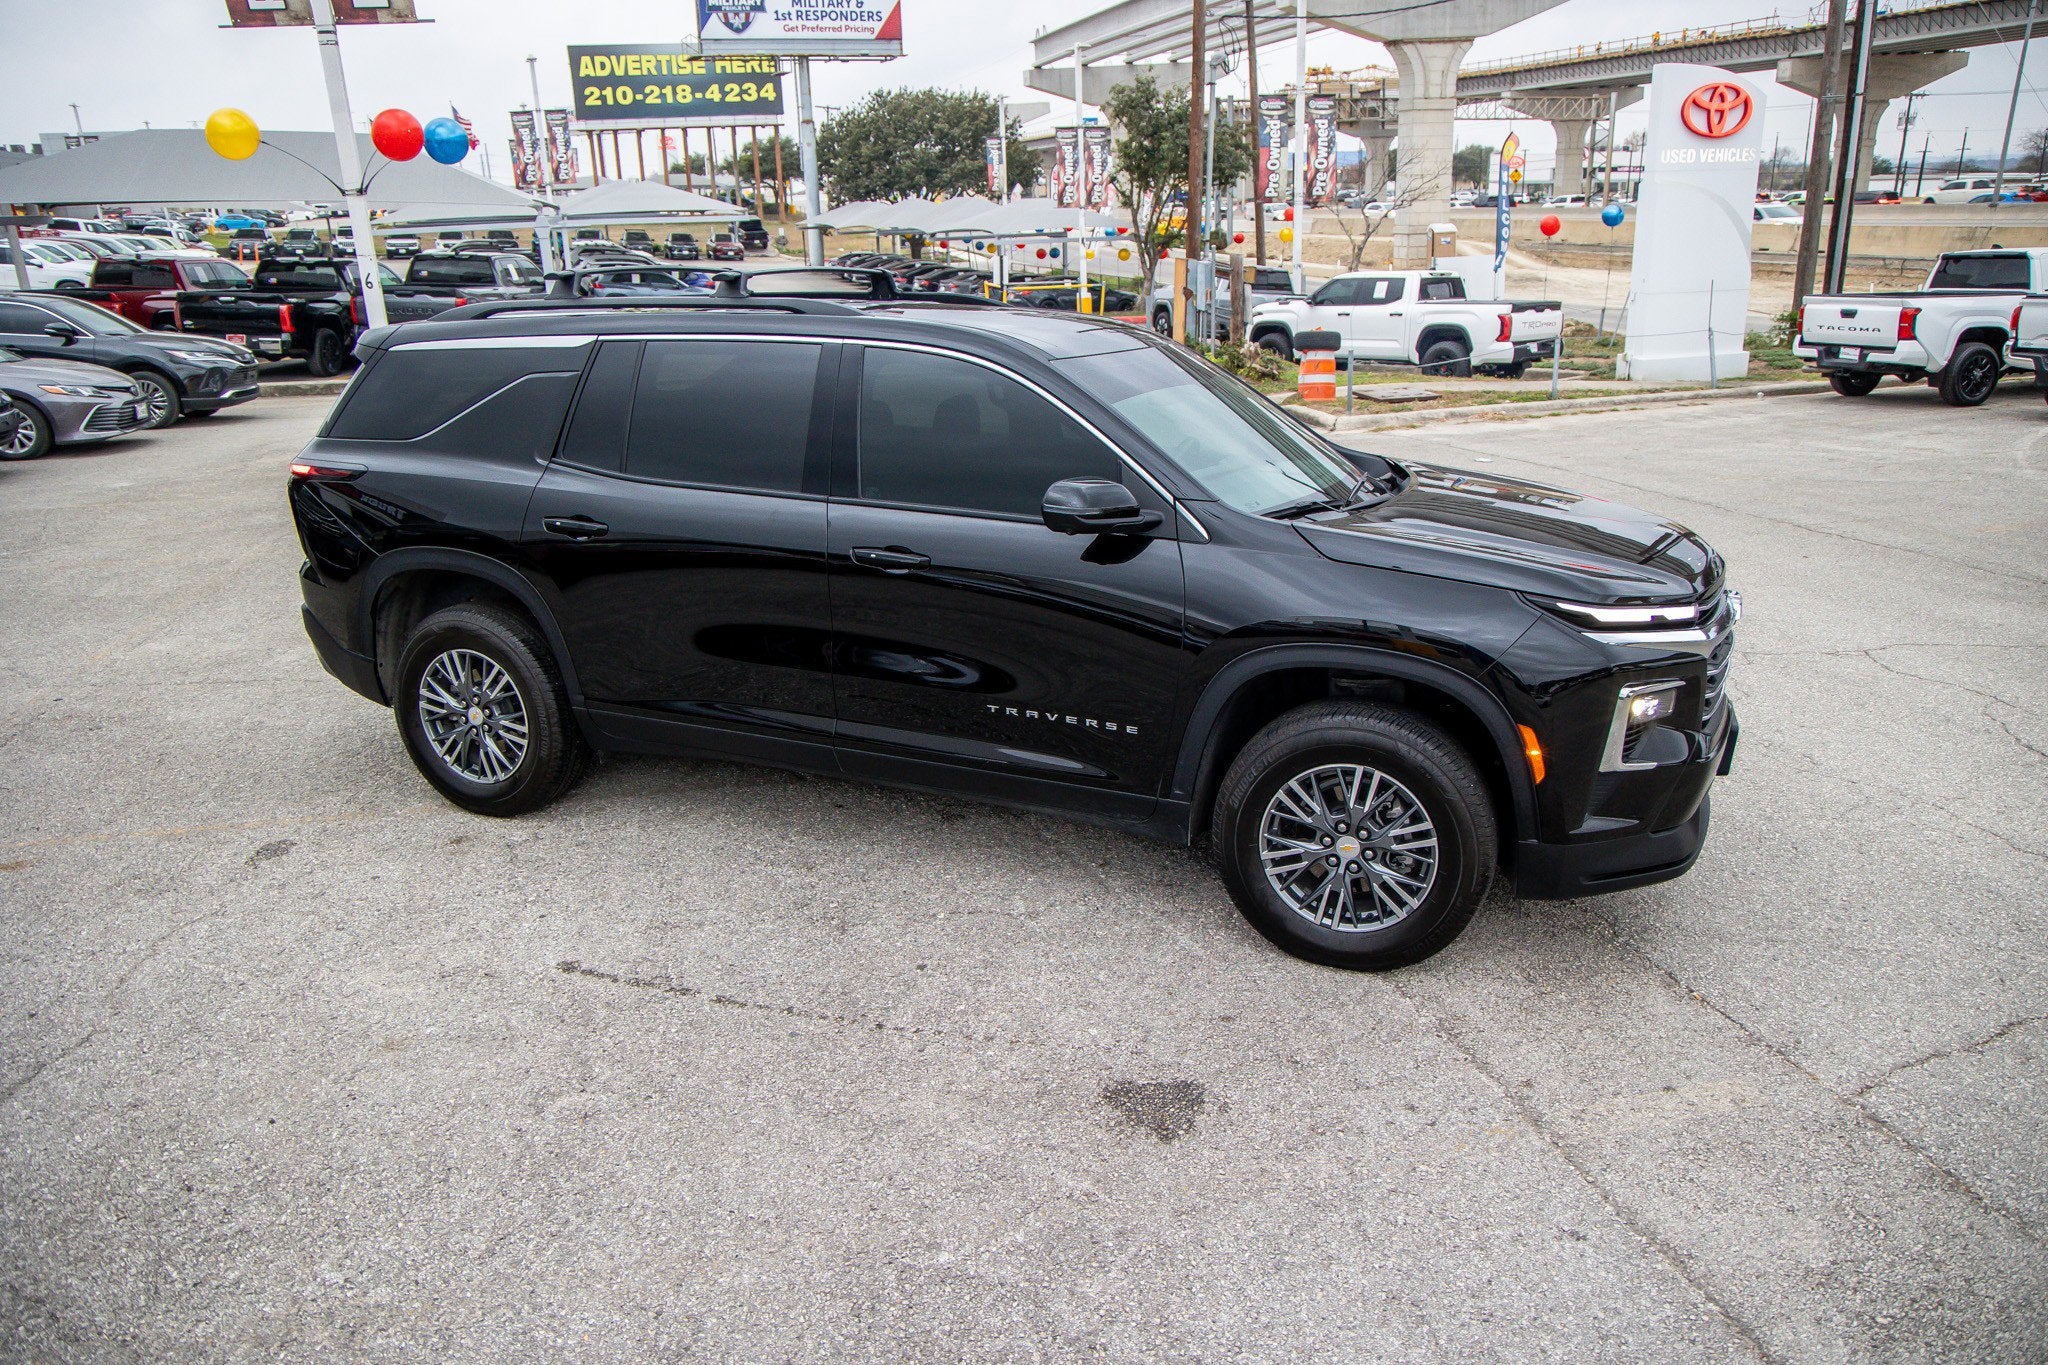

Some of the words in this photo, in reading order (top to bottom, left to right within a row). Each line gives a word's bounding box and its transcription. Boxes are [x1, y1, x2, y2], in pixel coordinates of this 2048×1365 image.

[774, 10, 792, 21] 1st
[796, 10, 883, 21] RESPONDERS
[791, 0, 851, 8] MILITARY
[783, 24, 799, 33] Get
[801, 24, 842, 33] Preferred
[844, 25, 875, 34] Pricing
[579, 54, 706, 77] ADVERTISE
[714, 56, 776, 74] HERE
[584, 82, 777, 106] 210-218-4234
[518, 127, 535, 163] Owned
[552, 126, 567, 161] Owned
[1266, 120, 1281, 170] Owned
[1314, 119, 1329, 169] Owned
[1062, 145, 1074, 183] Owned
[1090, 145, 1102, 183] Owned
[1660, 150, 1696, 164] USED
[1700, 147, 1756, 163] VEHICLES
[526, 164, 539, 182] Pre
[558, 162, 570, 180] Pre
[1063, 185, 1074, 203] Pre
[1091, 184, 1102, 203] Pre
[1265, 172, 1280, 197] Pre
[1312, 171, 1328, 196] Pre
[365, 272, 374, 289] 6
[1817, 324, 1881, 333] TACOMA
[986, 704, 1139, 735] TRAVERSE
